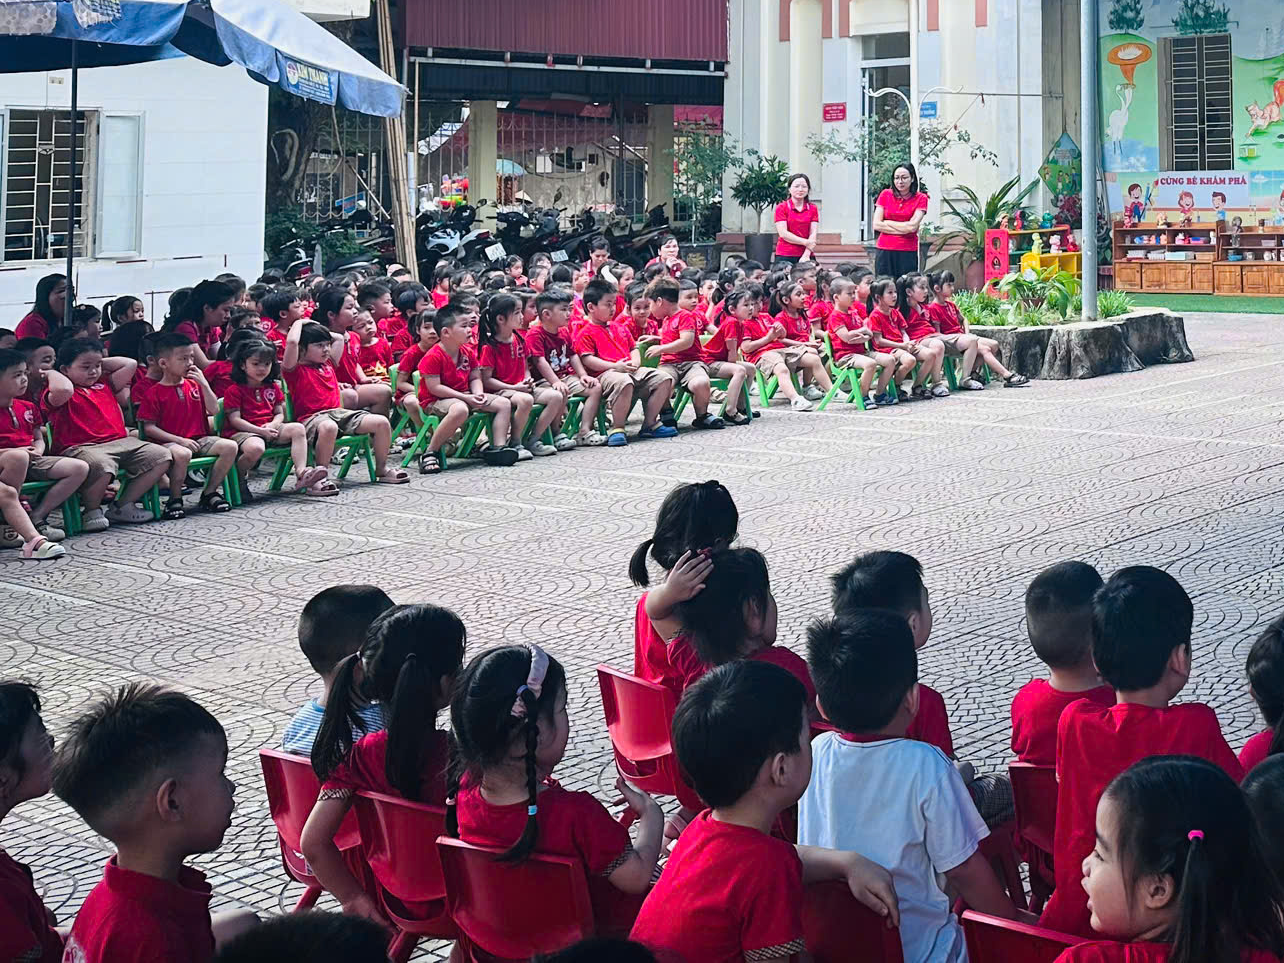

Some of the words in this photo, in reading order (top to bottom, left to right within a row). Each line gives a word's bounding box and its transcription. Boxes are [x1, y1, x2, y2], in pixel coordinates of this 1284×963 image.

[1160, 175, 1184, 185] CÙNG
[1199, 175, 1226, 185] KHÁM
[1228, 174, 1247, 185] PHÁ
